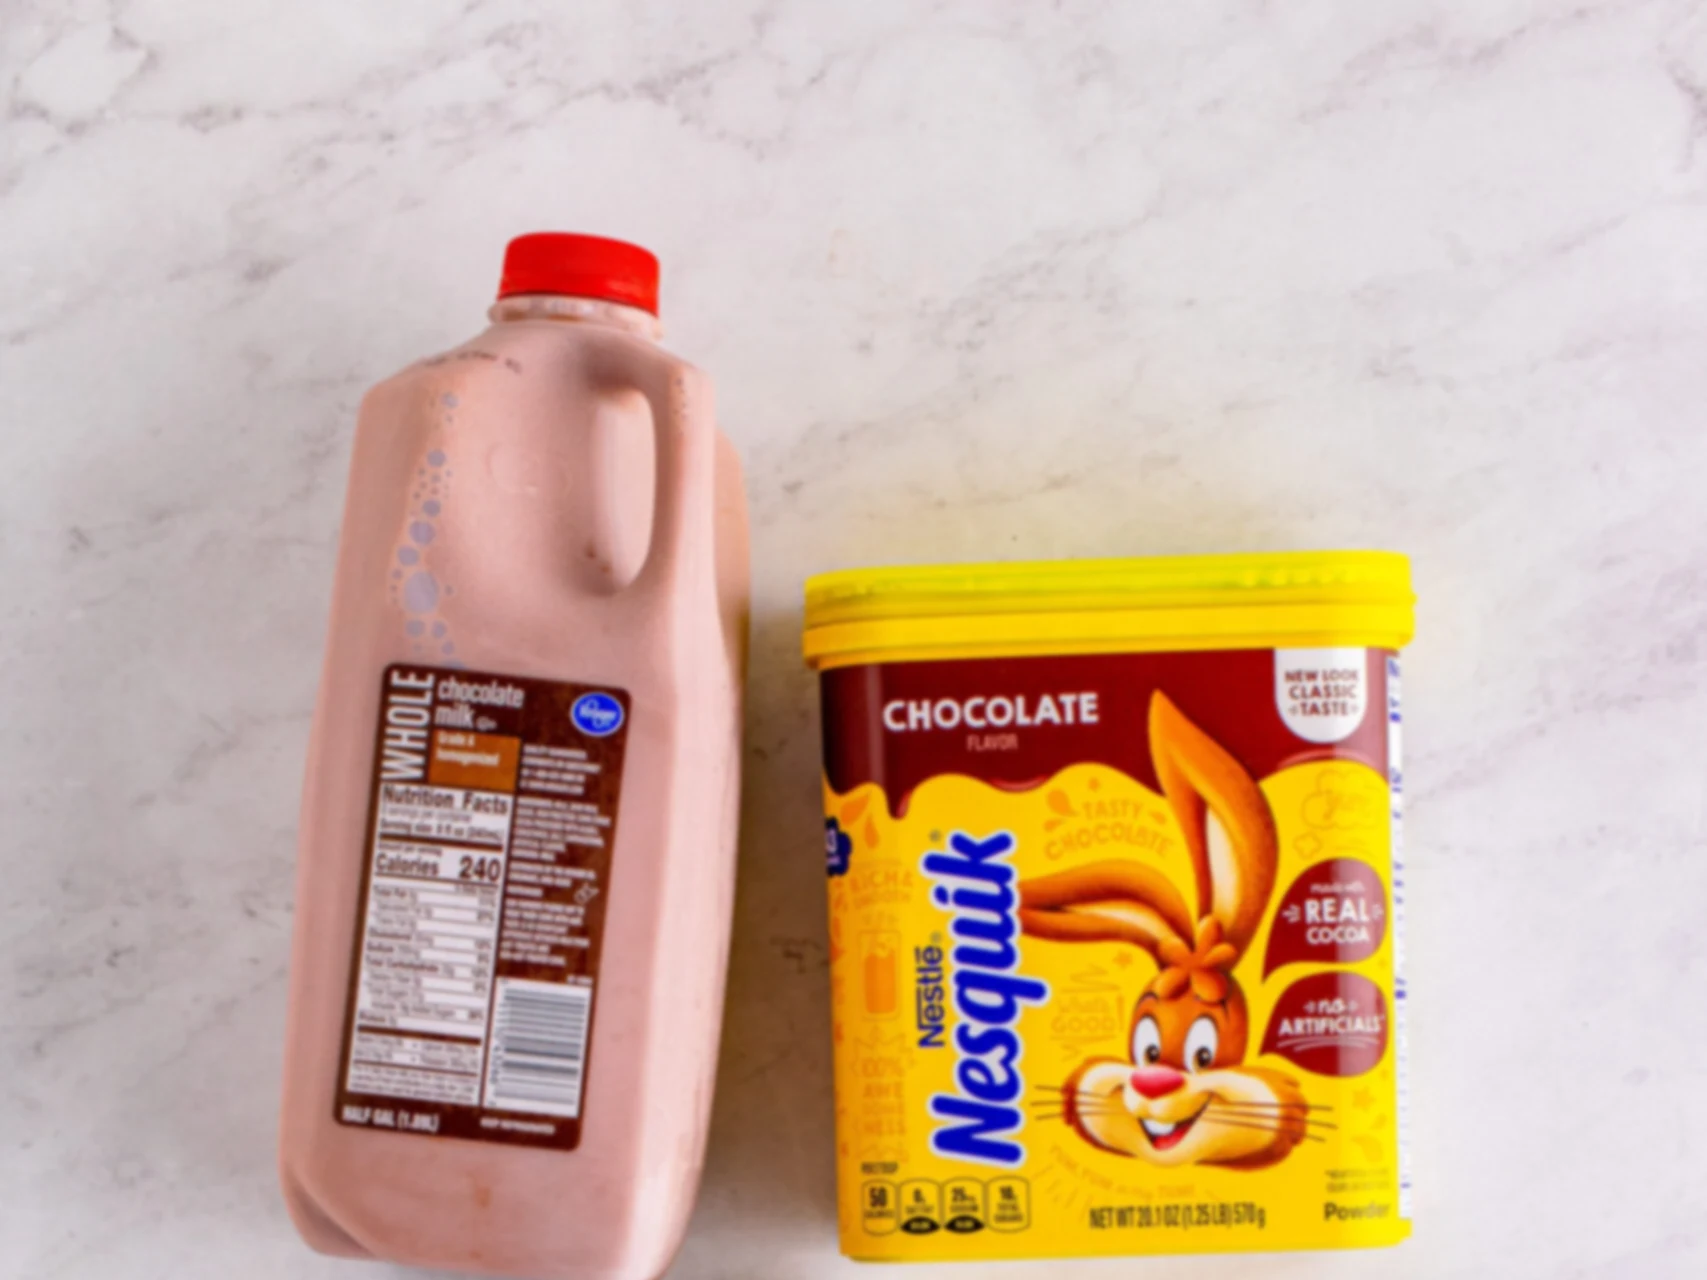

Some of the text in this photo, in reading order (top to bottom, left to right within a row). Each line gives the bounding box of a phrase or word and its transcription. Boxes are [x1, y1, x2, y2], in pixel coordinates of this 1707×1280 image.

[1284, 668, 1358, 683] NEW LOOK
[438, 676, 525, 709] chocolate
[1288, 684, 1357, 700] CLASSIC
[433, 702, 475, 729] milk
[882, 692, 1099, 732] CHOCOLATE
[1300, 701, 1348, 716] TASTE
[380, 671, 434, 780] WHOLE
[966, 733, 1018, 752] FLAVOR
[383, 785, 508, 815] Nutrition Facts
[376, 852, 439, 876] Calories
[459, 855, 501, 882] 240
[1304, 897, 1370, 924] REAL
[1306, 926, 1370, 945] COCOA
[922, 831, 1050, 1166] Nesquik
[1089, 1205, 1114, 1229] NET
[1116, 1204, 1135, 1228] WT
[1323, 1201, 1390, 1221] Powder
